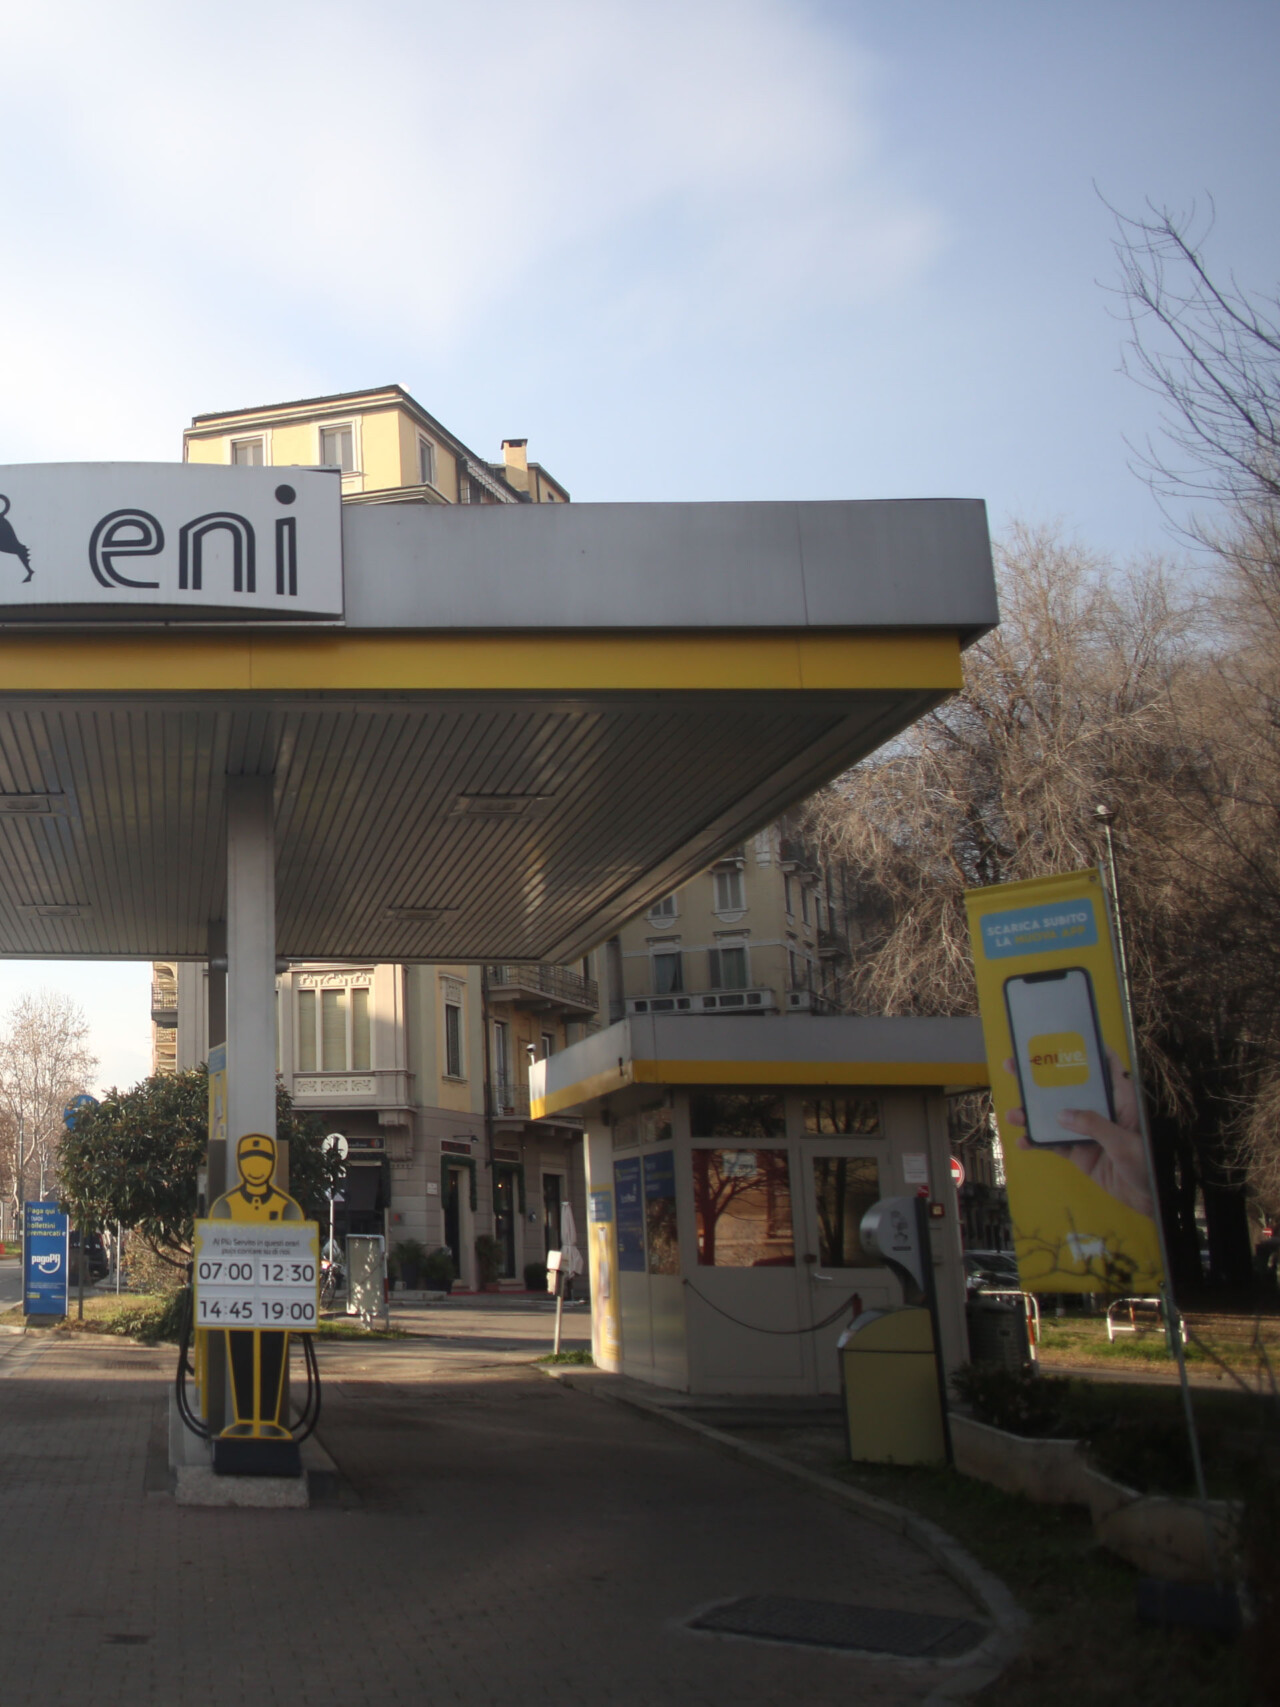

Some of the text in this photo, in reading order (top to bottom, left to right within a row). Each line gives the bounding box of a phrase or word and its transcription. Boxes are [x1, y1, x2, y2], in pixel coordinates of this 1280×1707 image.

[88, 484, 298, 597] eni
[986, 912, 1088, 936] SCARICA SUBITO
[995, 925, 1086, 947] LA NUOVA APP
[27, 1207, 44, 1215] Paga
[199, 1262, 315, 1282] 07:00 12:30
[199, 1300, 315, 1320] 14:45 19:00
